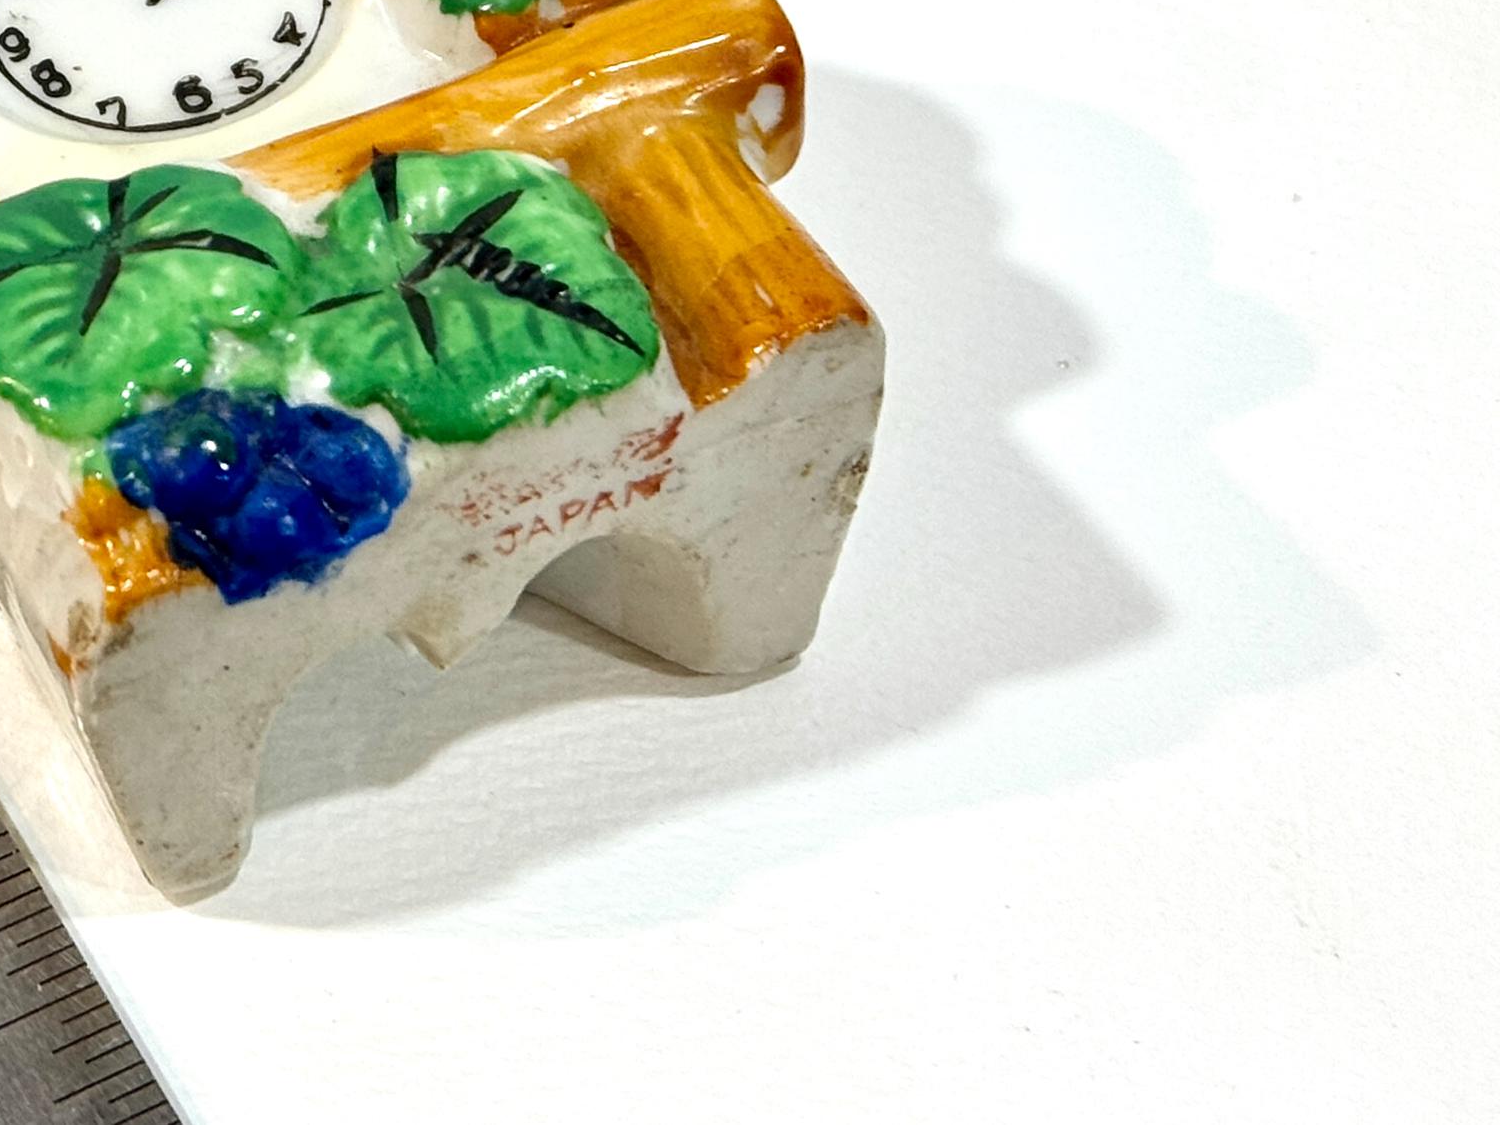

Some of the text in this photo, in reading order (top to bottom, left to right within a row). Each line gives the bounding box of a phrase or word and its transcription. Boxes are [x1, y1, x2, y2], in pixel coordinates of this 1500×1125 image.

[272, 11, 306, 46] 4
[30, 58, 72, 98] 8
[172, 74, 213, 113] 6
[230, 58, 264, 94] 5
[96, 96, 127, 128] 7
[494, 467, 675, 555] JAPAN
